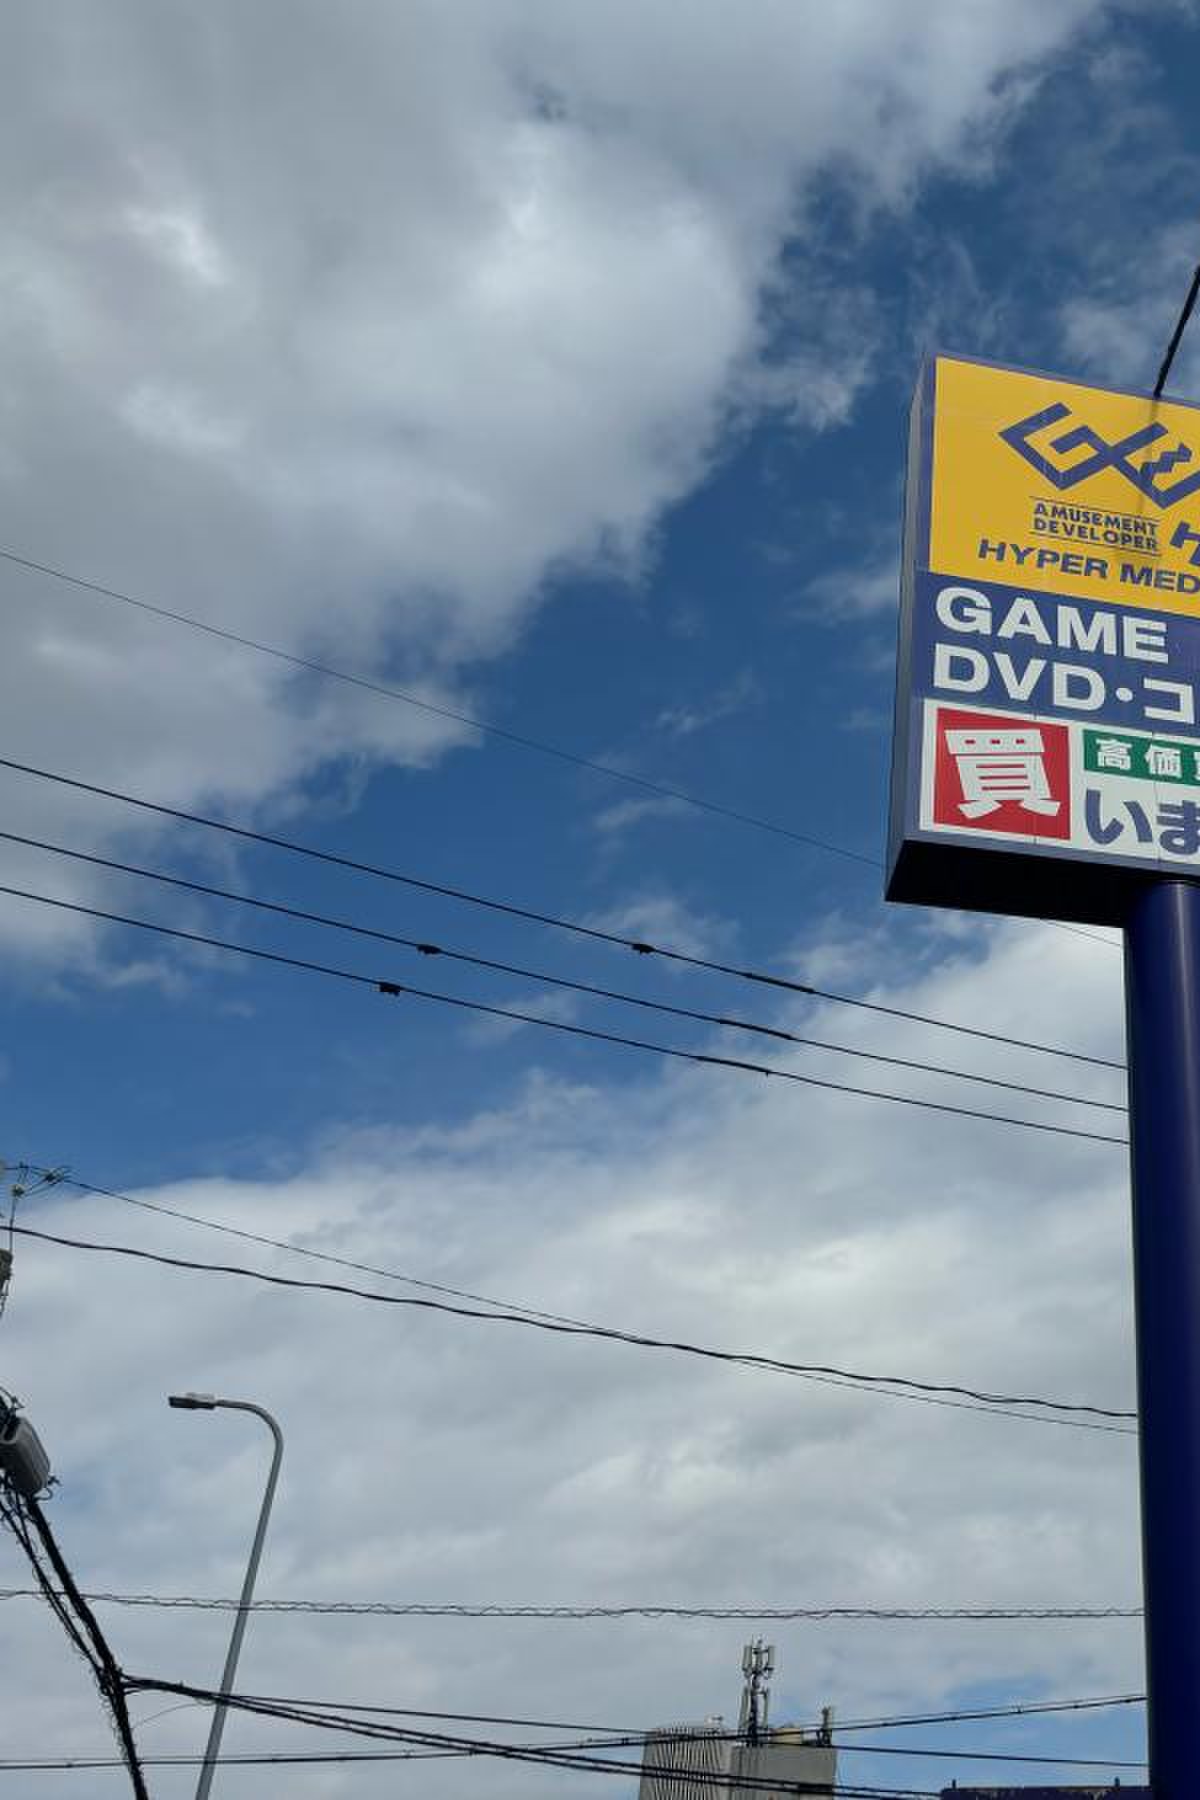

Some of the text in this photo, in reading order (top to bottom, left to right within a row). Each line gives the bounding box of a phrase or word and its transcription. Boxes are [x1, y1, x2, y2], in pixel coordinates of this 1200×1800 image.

[1033, 502, 1158, 534] AMUSEMENT
[1033, 517, 1158, 551] DEVELOPER
[977, 538, 1108, 580] HYPER
[935, 586, 1169, 664] GAME
[944, 728, 1061, 818] 買
